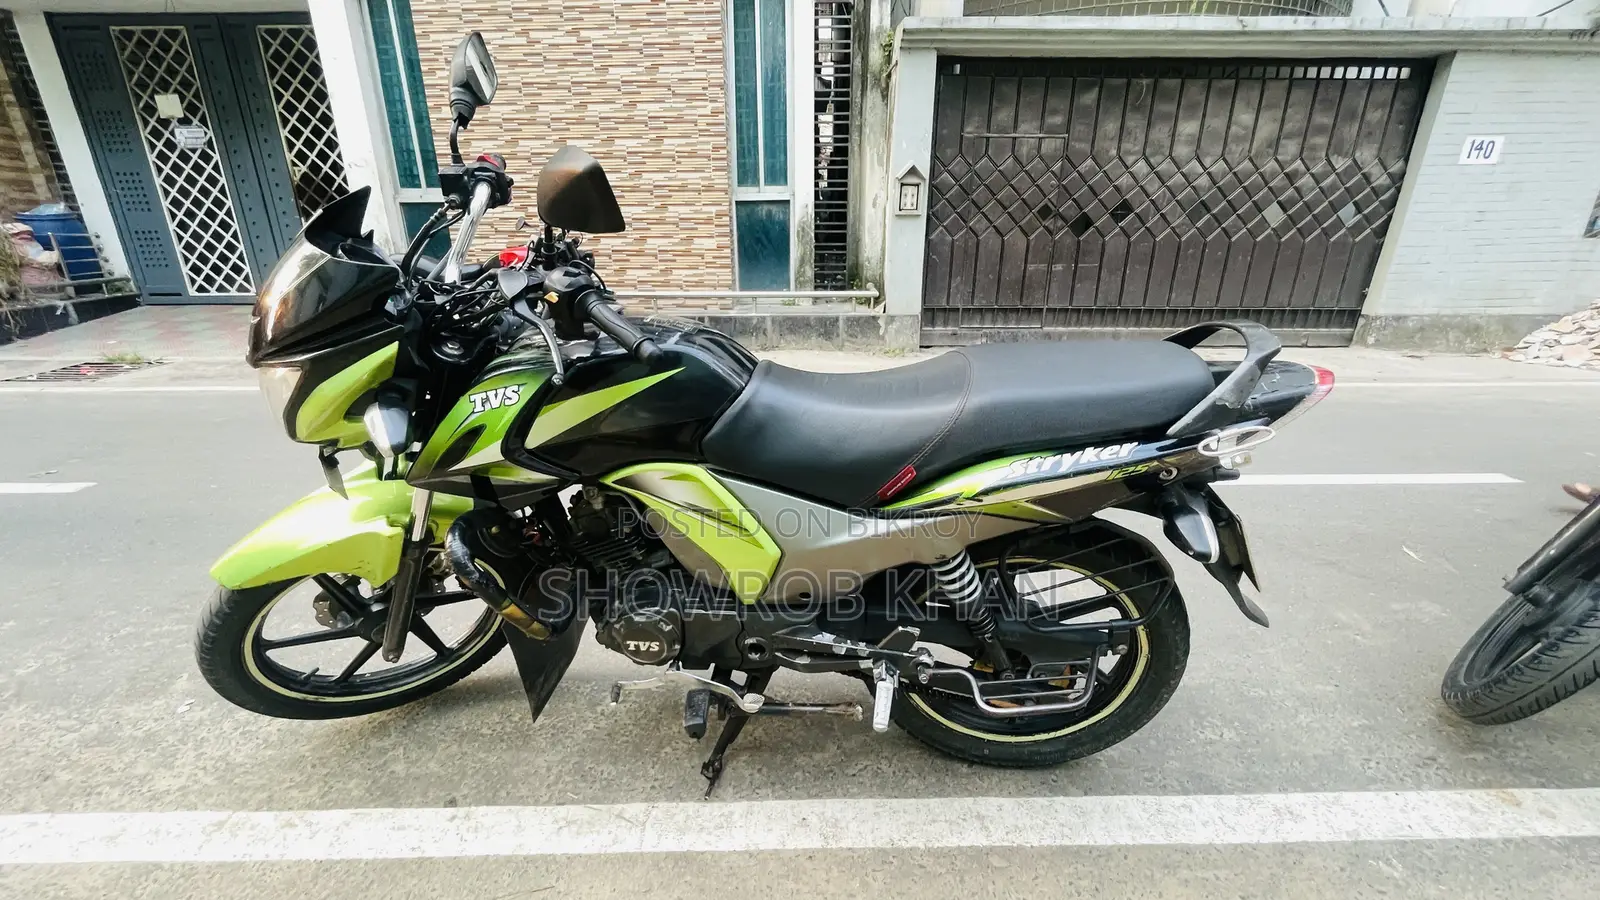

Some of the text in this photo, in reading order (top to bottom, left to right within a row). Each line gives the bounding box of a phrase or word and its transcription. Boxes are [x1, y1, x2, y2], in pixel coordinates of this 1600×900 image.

[1467, 139, 1495, 159] 140
[469, 384, 520, 413] TVS
[1006, 442, 1138, 478] Stryker
[1106, 464, 1150, 481] 125
[626, 640, 660, 651] TVS
